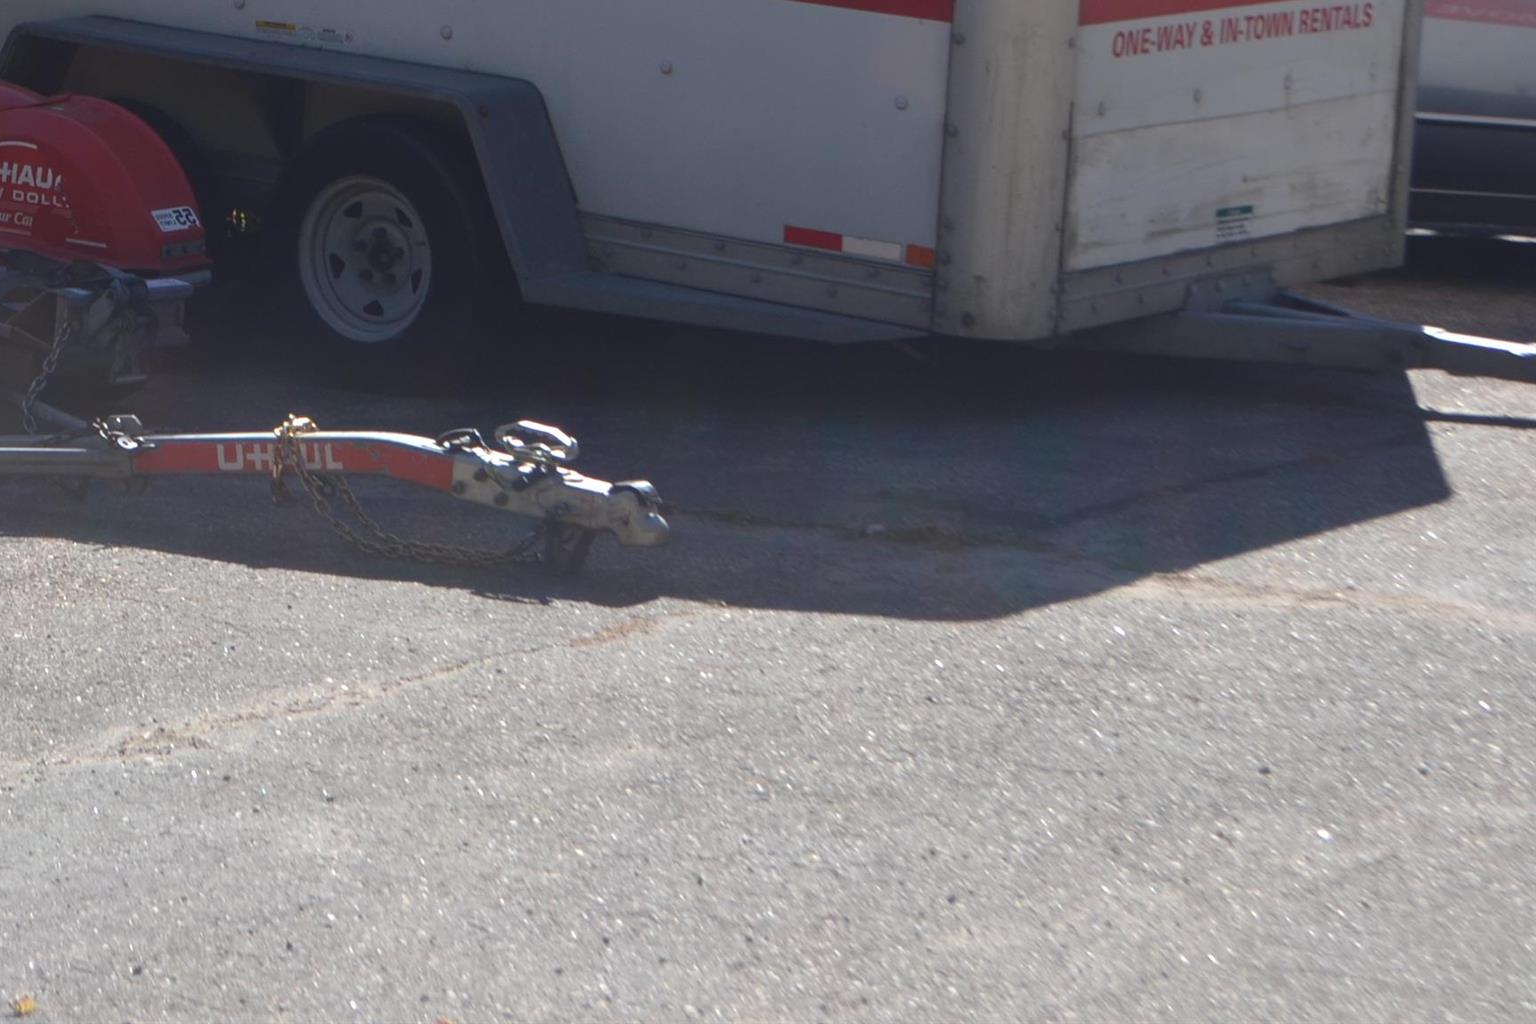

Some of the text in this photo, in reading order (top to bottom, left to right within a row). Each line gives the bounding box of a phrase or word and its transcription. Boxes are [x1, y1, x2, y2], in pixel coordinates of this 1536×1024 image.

[1112, 2, 1374, 59] ONE-WAY & IN-TOWN RENTALS
